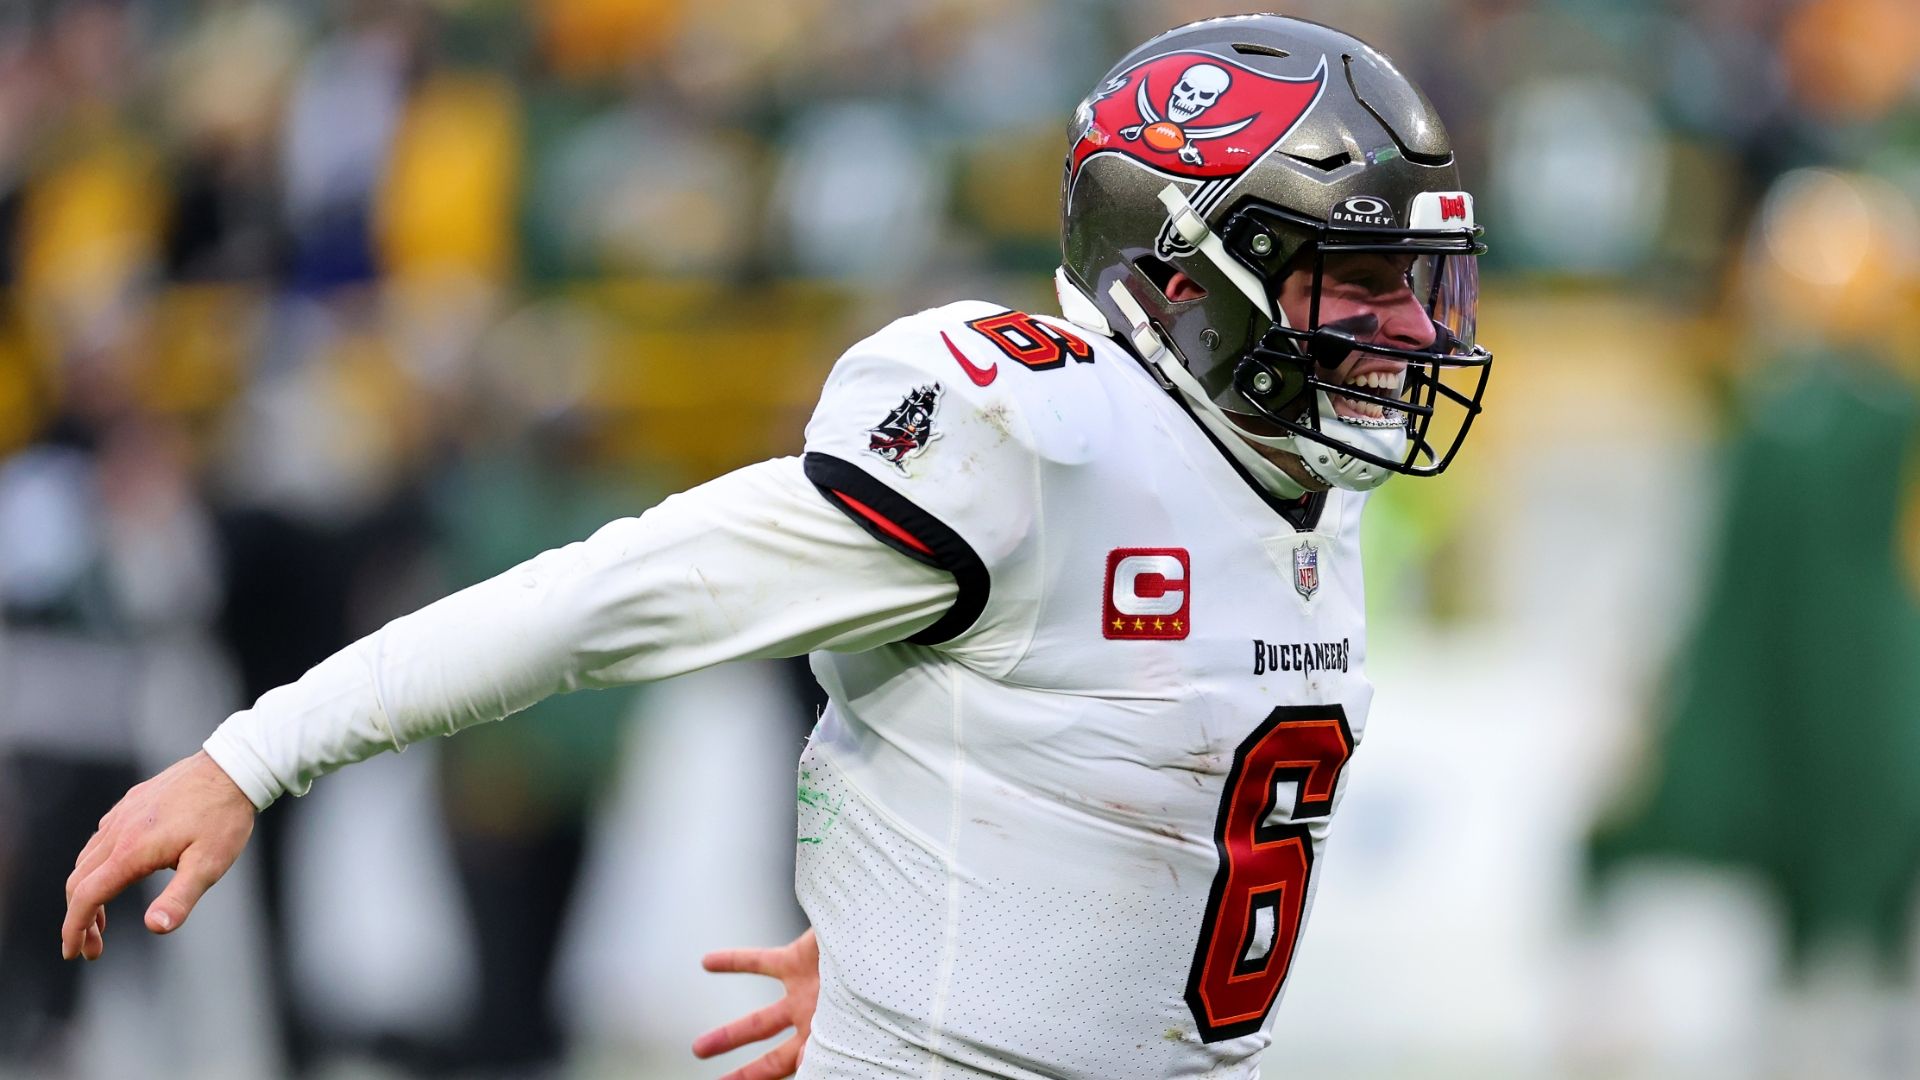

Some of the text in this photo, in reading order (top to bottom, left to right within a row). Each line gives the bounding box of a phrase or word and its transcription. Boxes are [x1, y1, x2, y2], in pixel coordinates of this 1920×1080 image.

[1333, 212, 1391, 225] OAKLEY
[964, 310, 1095, 372] 6
[1112, 555, 1185, 616] C
[1298, 567, 1317, 590] NFL
[1252, 637, 1350, 681] BUCCANEERS
[1184, 703, 1355, 1044] 6
